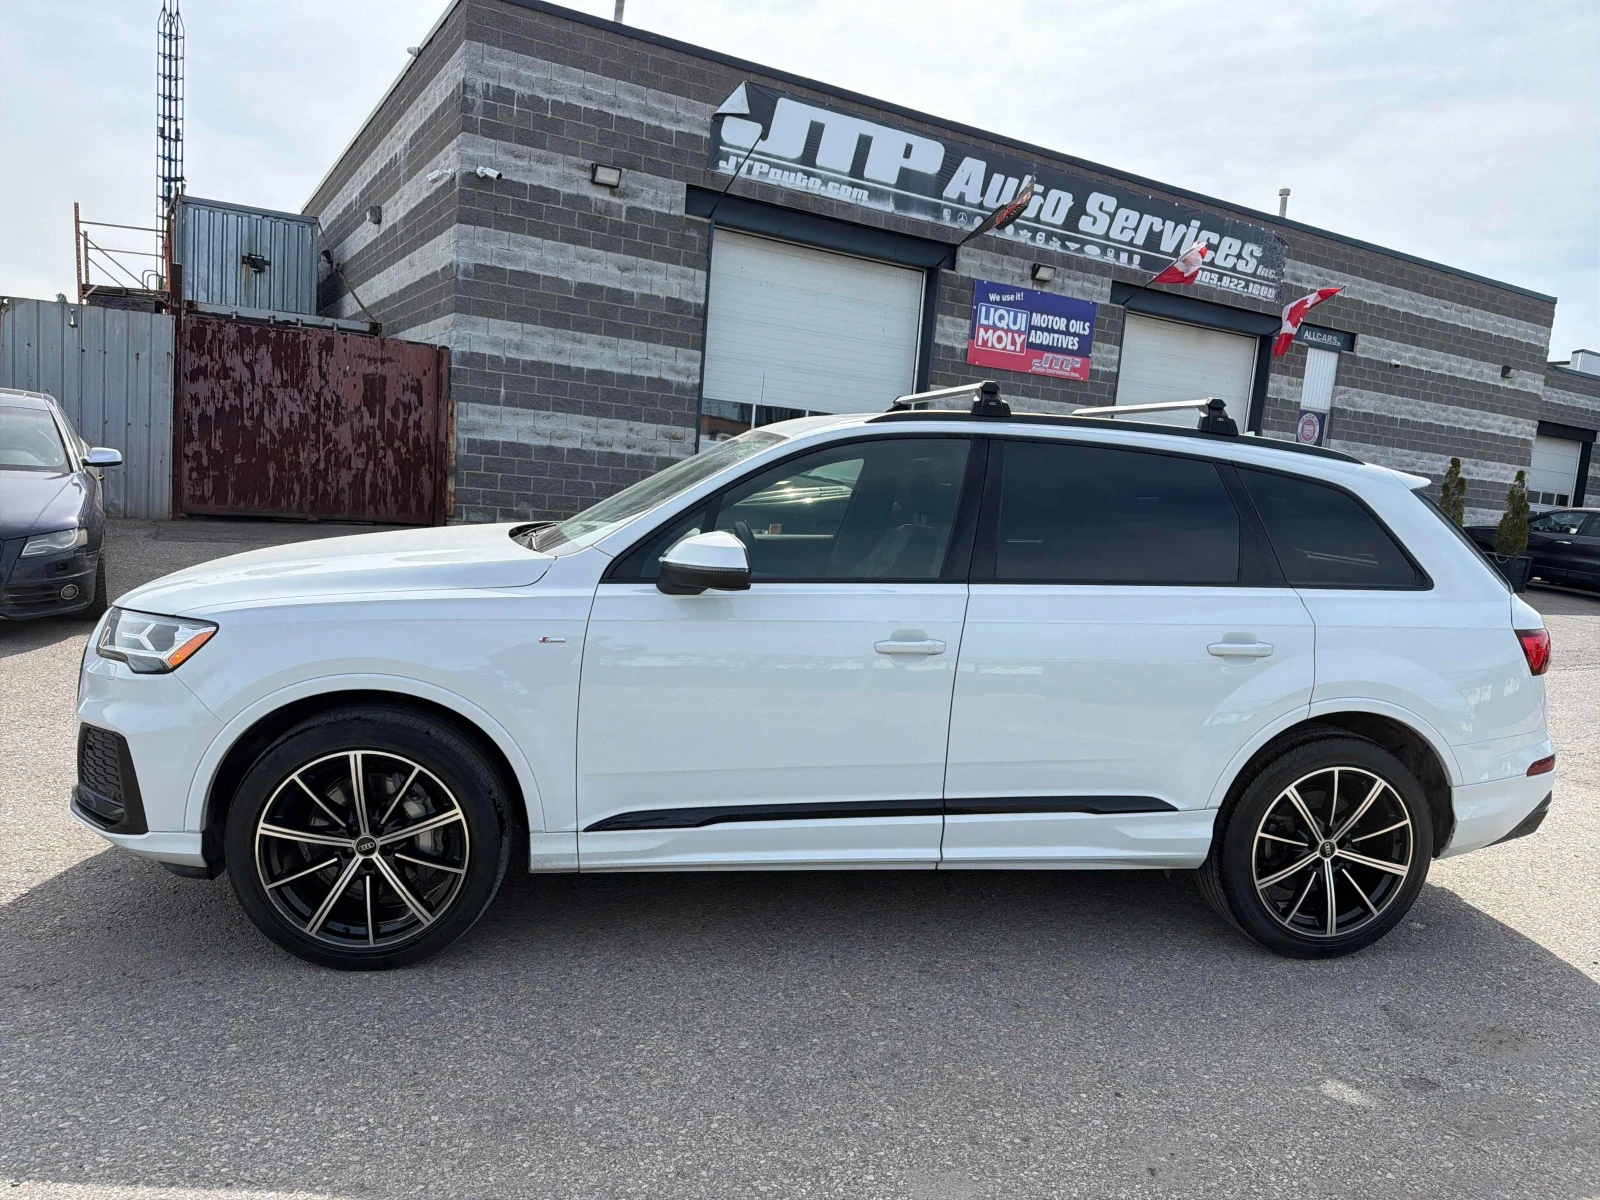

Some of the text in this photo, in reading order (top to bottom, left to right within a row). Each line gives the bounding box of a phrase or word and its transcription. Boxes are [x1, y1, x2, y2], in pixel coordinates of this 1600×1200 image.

[719, 155, 869, 201] JTPauto.com
[721, 97, 945, 184] JTP
[943, 156, 1074, 225] Auto
[1078, 191, 1263, 273] Services
[989, 292, 1024, 302] We use it!
[980, 306, 1027, 331] LIQUI
[1031, 312, 1090, 335] MOTOR OILS
[977, 327, 1026, 352] MOLY
[1029, 329, 1079, 350] ADDITIVES
[1303, 330, 1338, 344] ALLCARS
